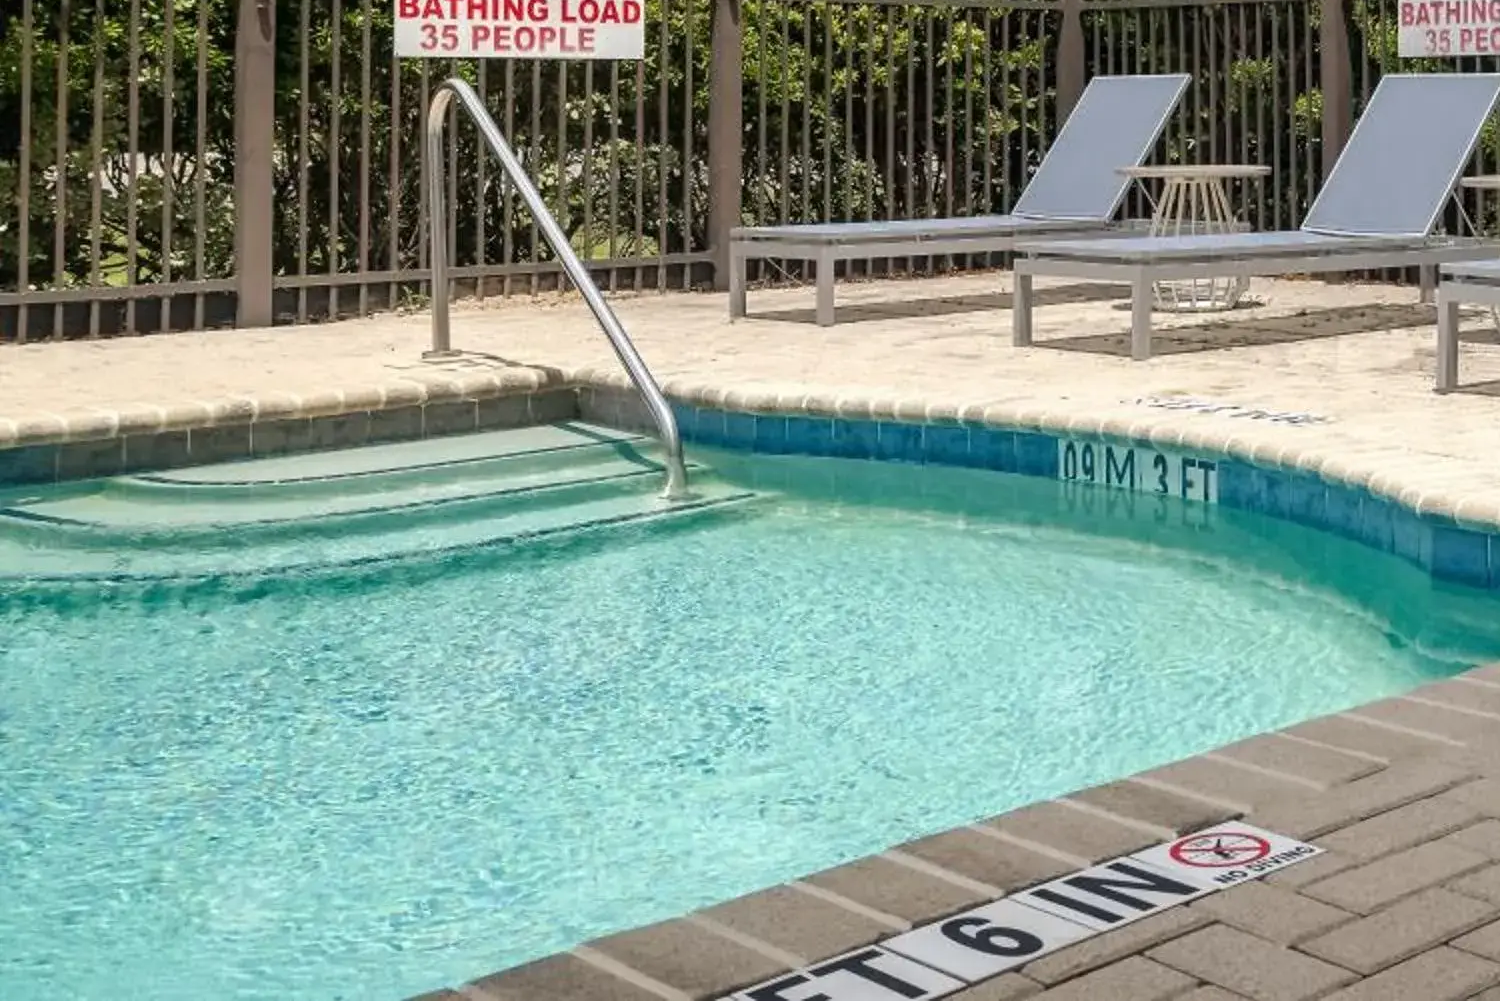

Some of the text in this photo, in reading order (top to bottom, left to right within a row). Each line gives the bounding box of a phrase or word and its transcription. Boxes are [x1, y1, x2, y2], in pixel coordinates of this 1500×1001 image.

[420, 24, 596, 53] 35 PEOPLE
[1425, 29, 1451, 53] 35
[1181, 456, 1217, 501] FT
[940, 916, 1044, 958] 6
[1029, 862, 1201, 924] IN
